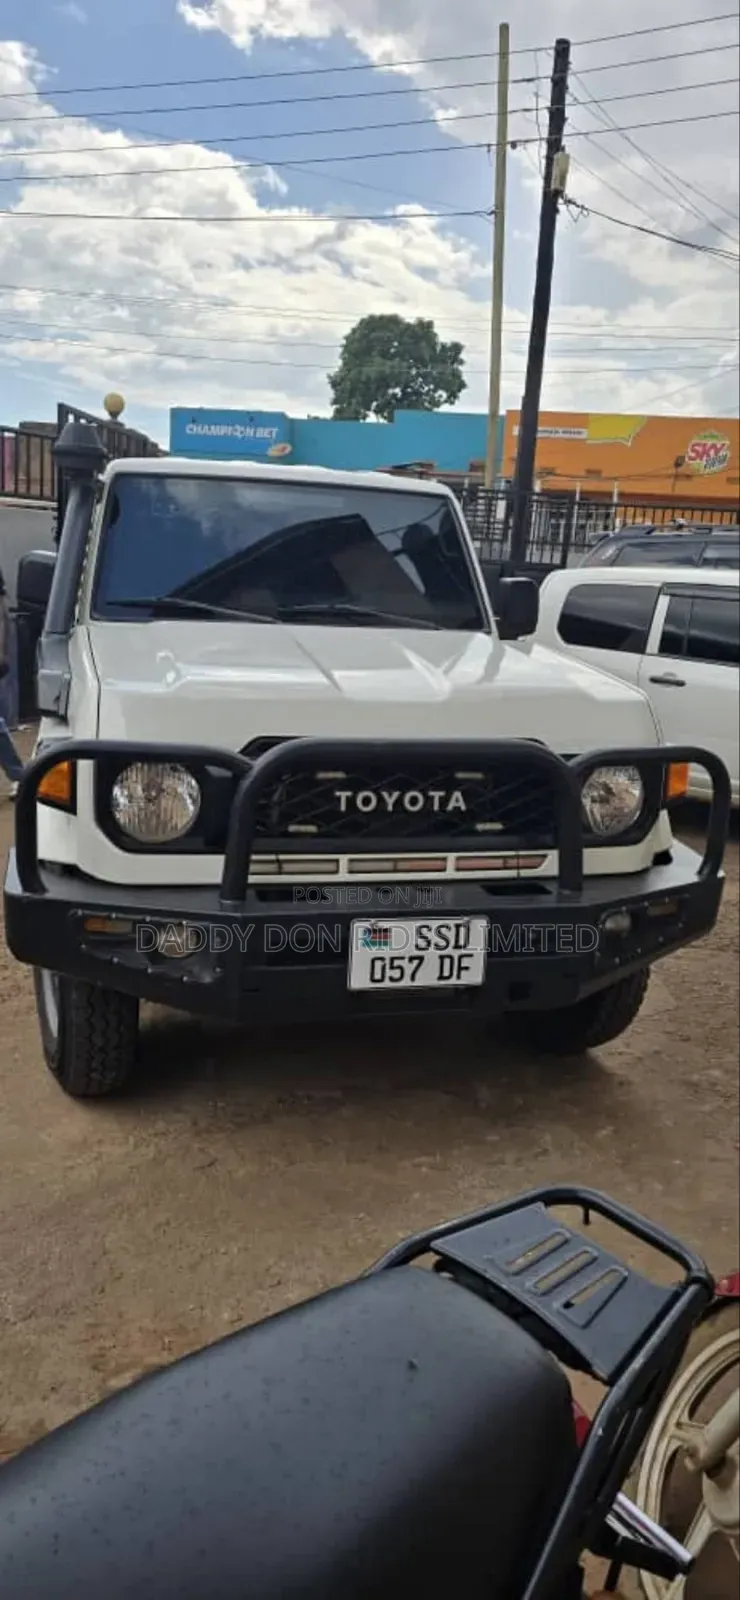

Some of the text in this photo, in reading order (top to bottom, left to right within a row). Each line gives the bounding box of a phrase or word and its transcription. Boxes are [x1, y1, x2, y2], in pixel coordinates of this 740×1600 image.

[255, 426, 279, 439] BET
[334, 790, 467, 812] TOYOTA
[415, 924, 470, 951] SSD
[369, 954, 474, 983] 057 DF
